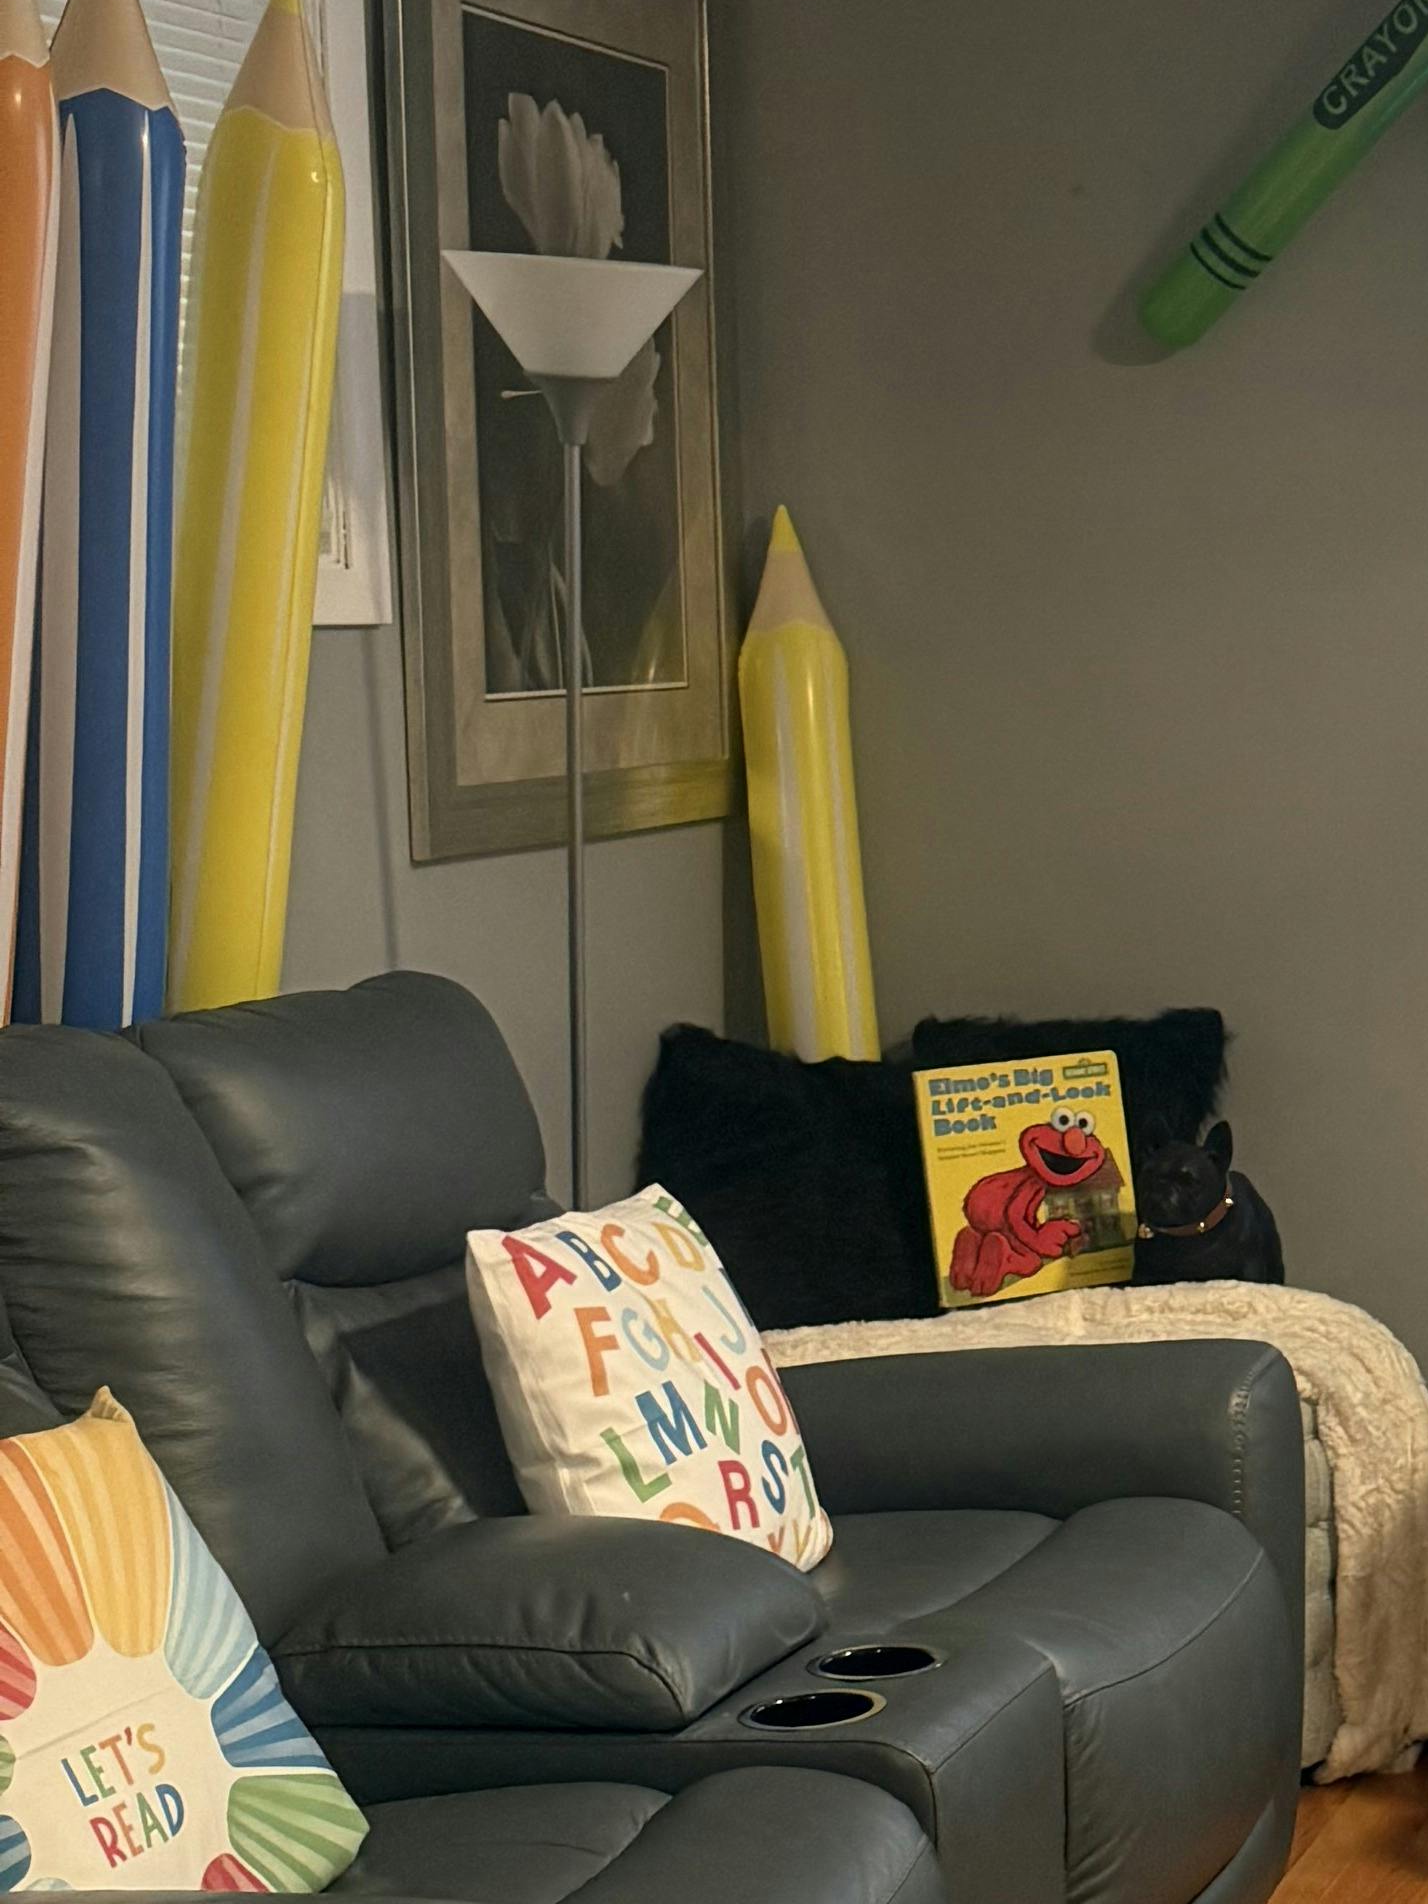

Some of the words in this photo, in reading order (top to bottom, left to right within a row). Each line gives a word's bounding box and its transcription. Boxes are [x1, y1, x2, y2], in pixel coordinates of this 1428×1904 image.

[929, 1072, 1011, 1096] Elmo's
[1013, 1067, 1054, 1087] Big
[931, 1081, 1112, 1116] Lift-and-Look
[933, 1113, 997, 1136] Book
[60, 1722, 168, 1808] LET'S
[88, 1783, 185, 1869] READ
